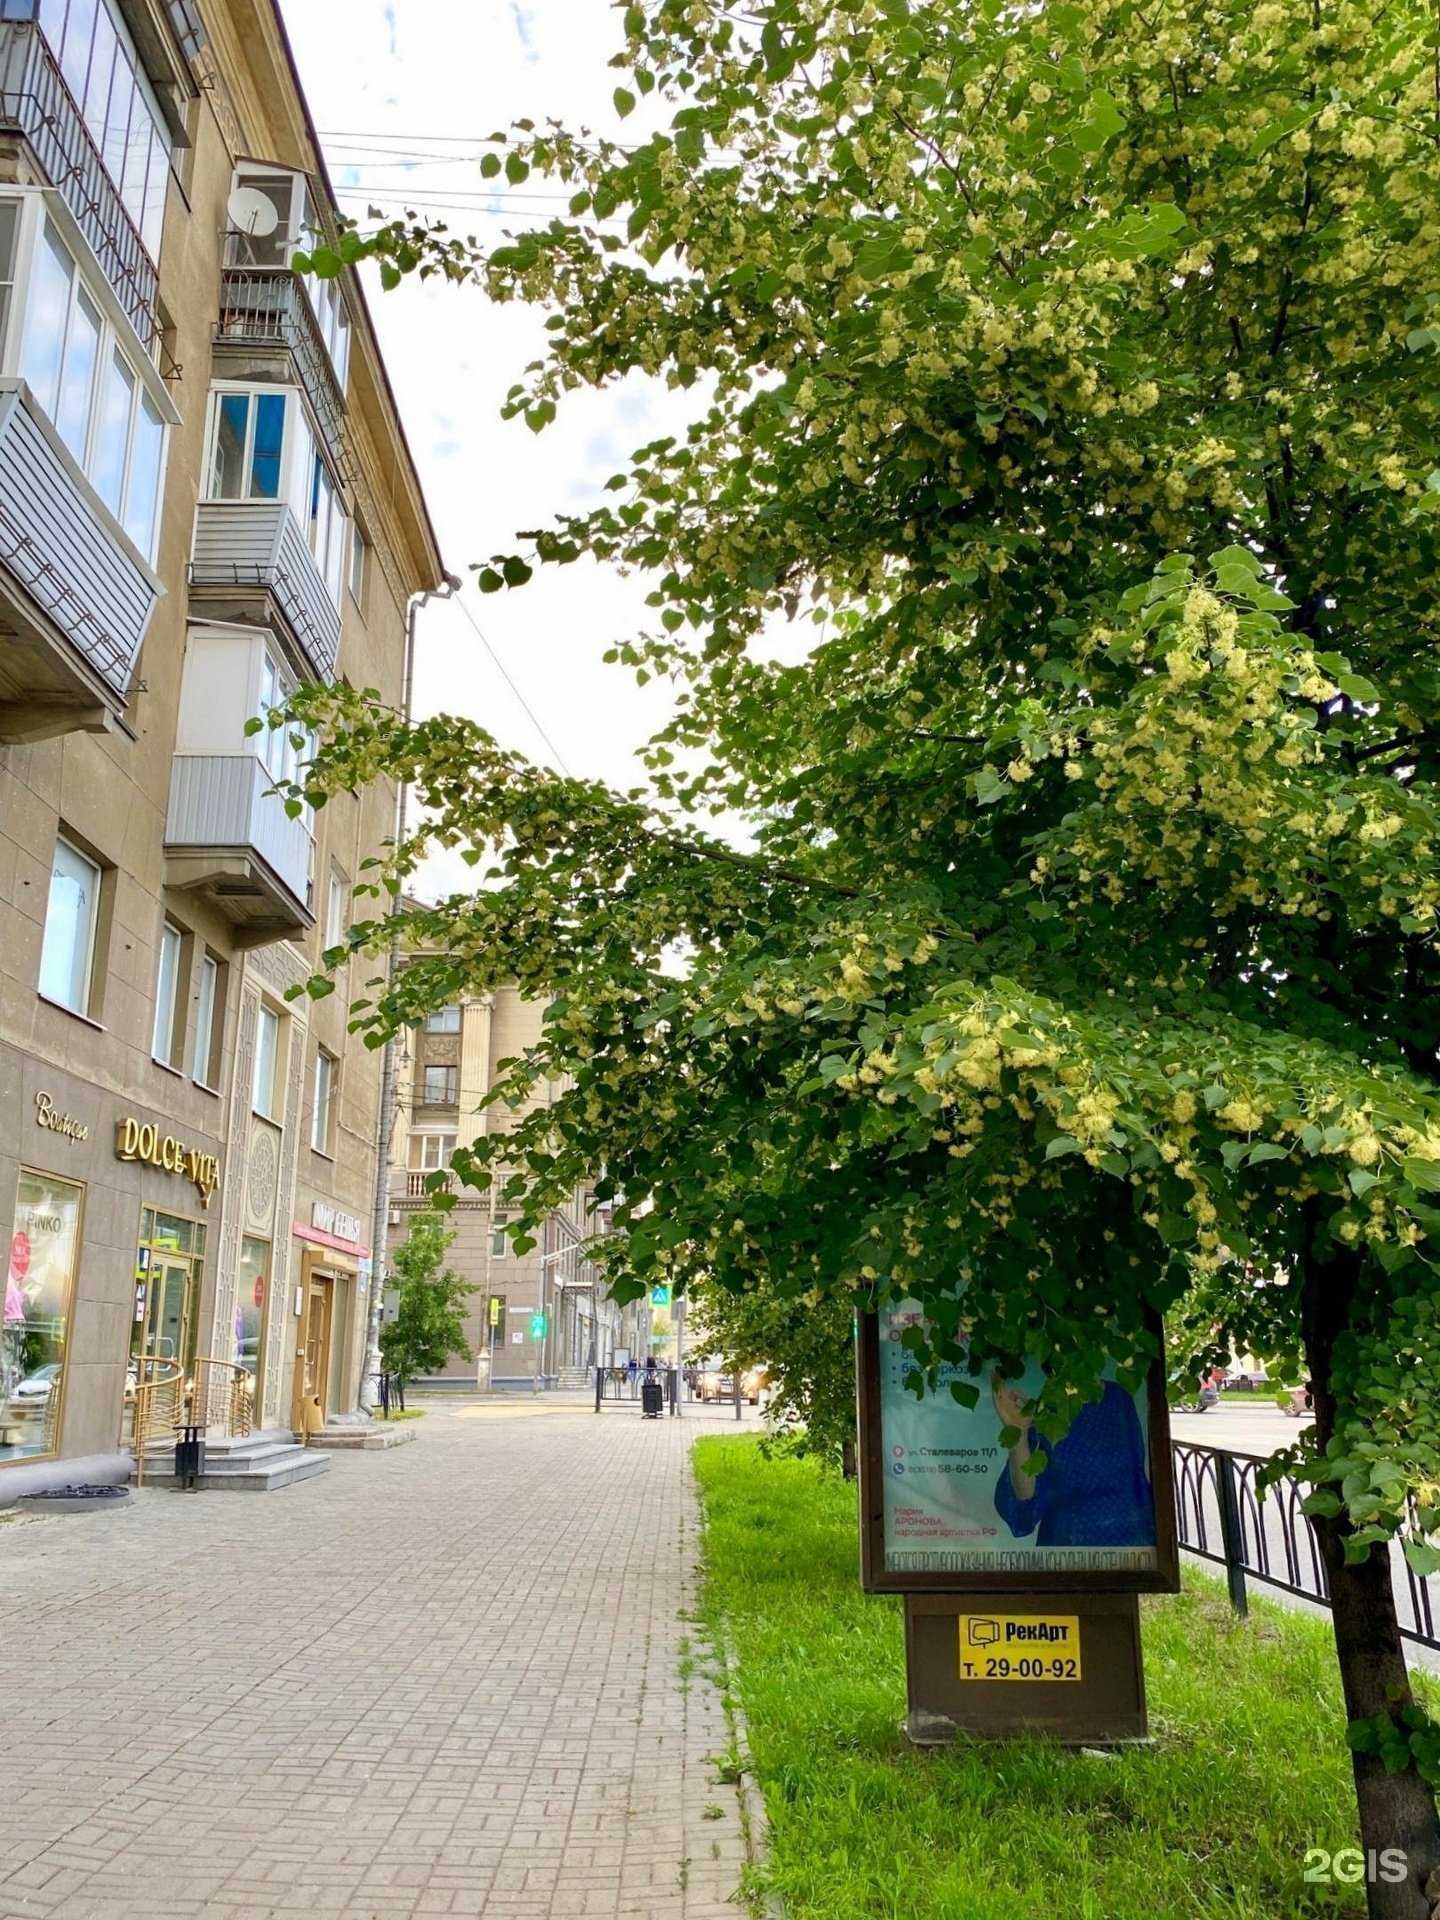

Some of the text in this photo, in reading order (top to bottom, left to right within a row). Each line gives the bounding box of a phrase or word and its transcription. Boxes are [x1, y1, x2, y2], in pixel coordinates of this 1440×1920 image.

[119, 1117, 221, 1190] DOLCE VITA
[920, 1447, 979, 1458] Сталеваров
[938, 1464, 989, 1474] 58-60-50
[1005, 1622, 1069, 1642] РекАрт
[985, 1657, 1077, 1678] 29-00-92
